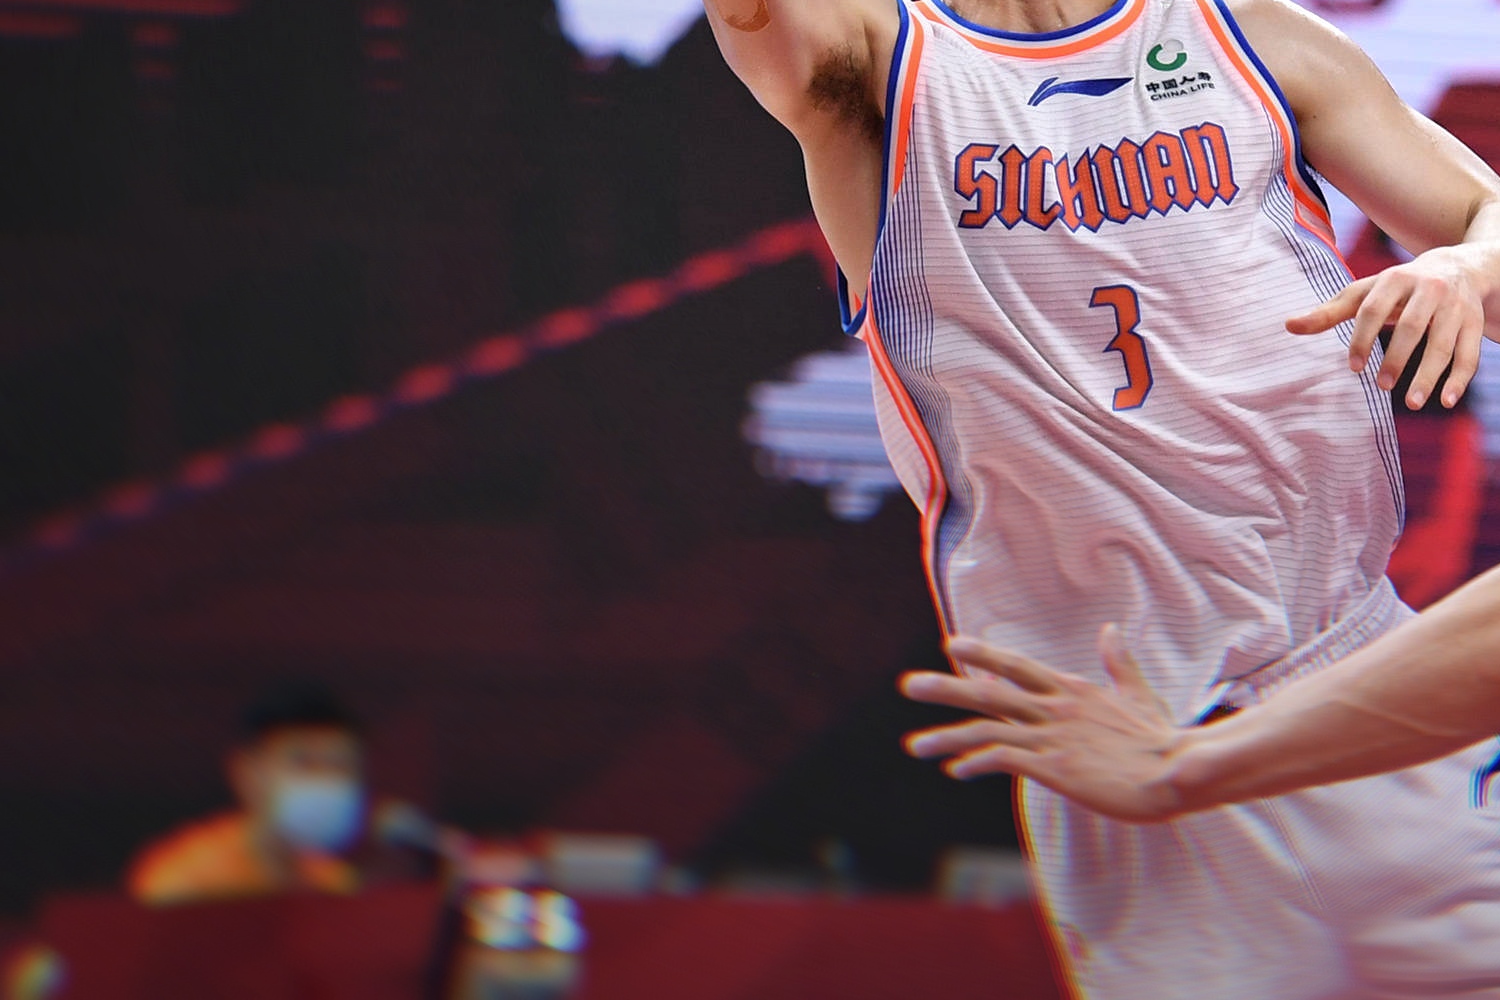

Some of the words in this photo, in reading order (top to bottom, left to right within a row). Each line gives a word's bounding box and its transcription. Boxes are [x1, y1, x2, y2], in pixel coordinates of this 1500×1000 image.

[1145, 71, 1212, 93] 中国人寿
[1150, 89, 1188, 101] CHINA
[1190, 82, 1216, 93] LIFE
[954, 120, 1240, 233] SICHUAN
[1089, 284, 1154, 412] 3
